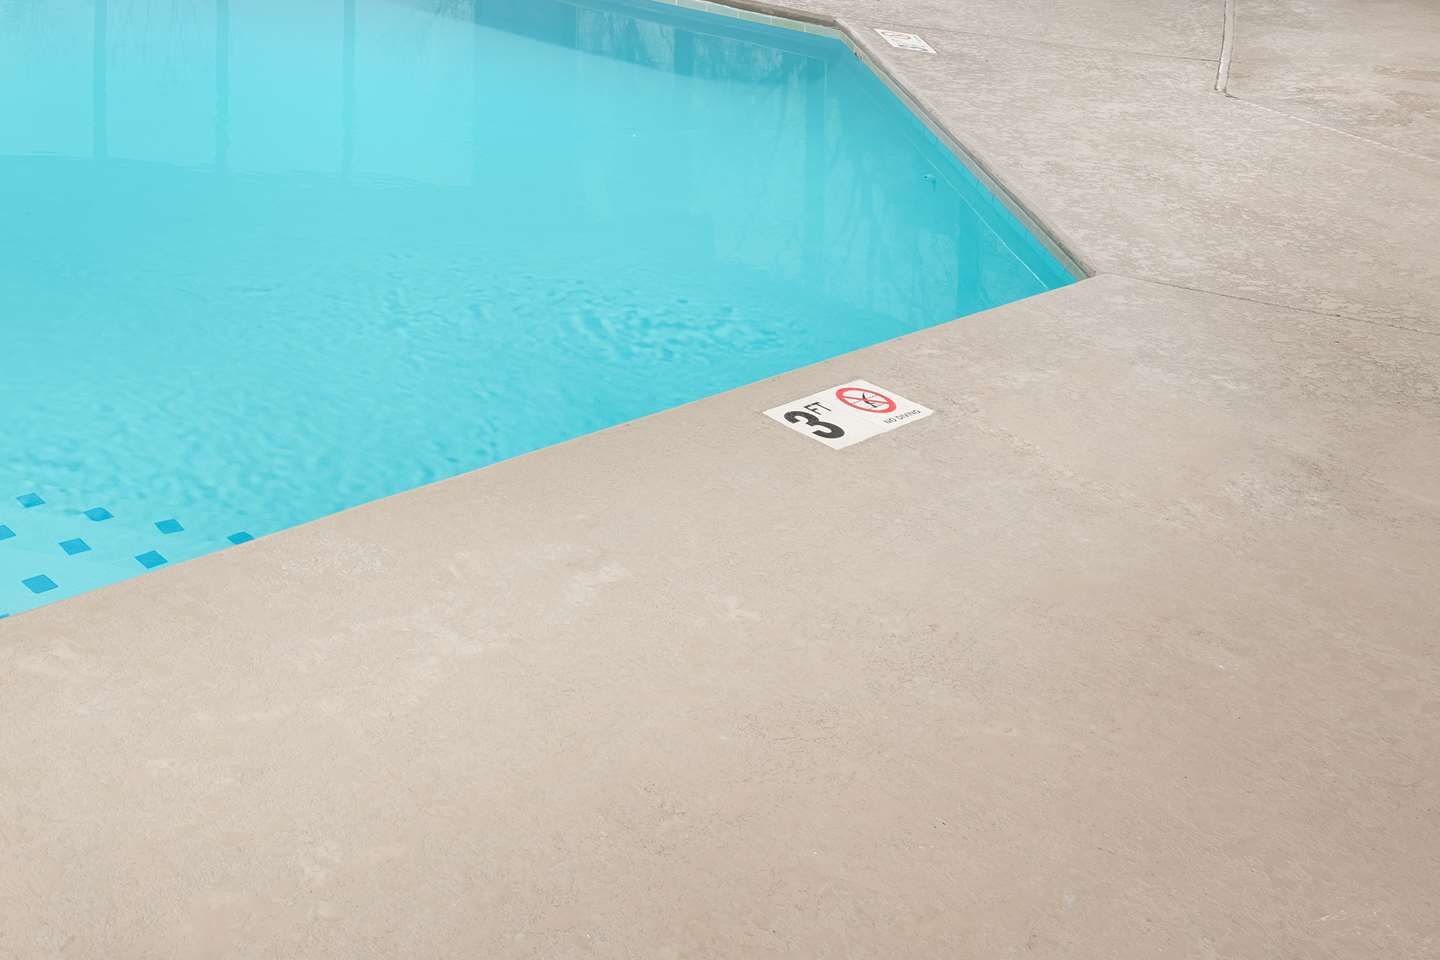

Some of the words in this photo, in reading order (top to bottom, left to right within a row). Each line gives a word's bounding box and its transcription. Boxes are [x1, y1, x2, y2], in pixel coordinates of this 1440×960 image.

[803, 401, 832, 416] FT
[883, 416, 897, 424] NO
[895, 409, 921, 420] DIVING
[783, 410, 846, 439] 3
